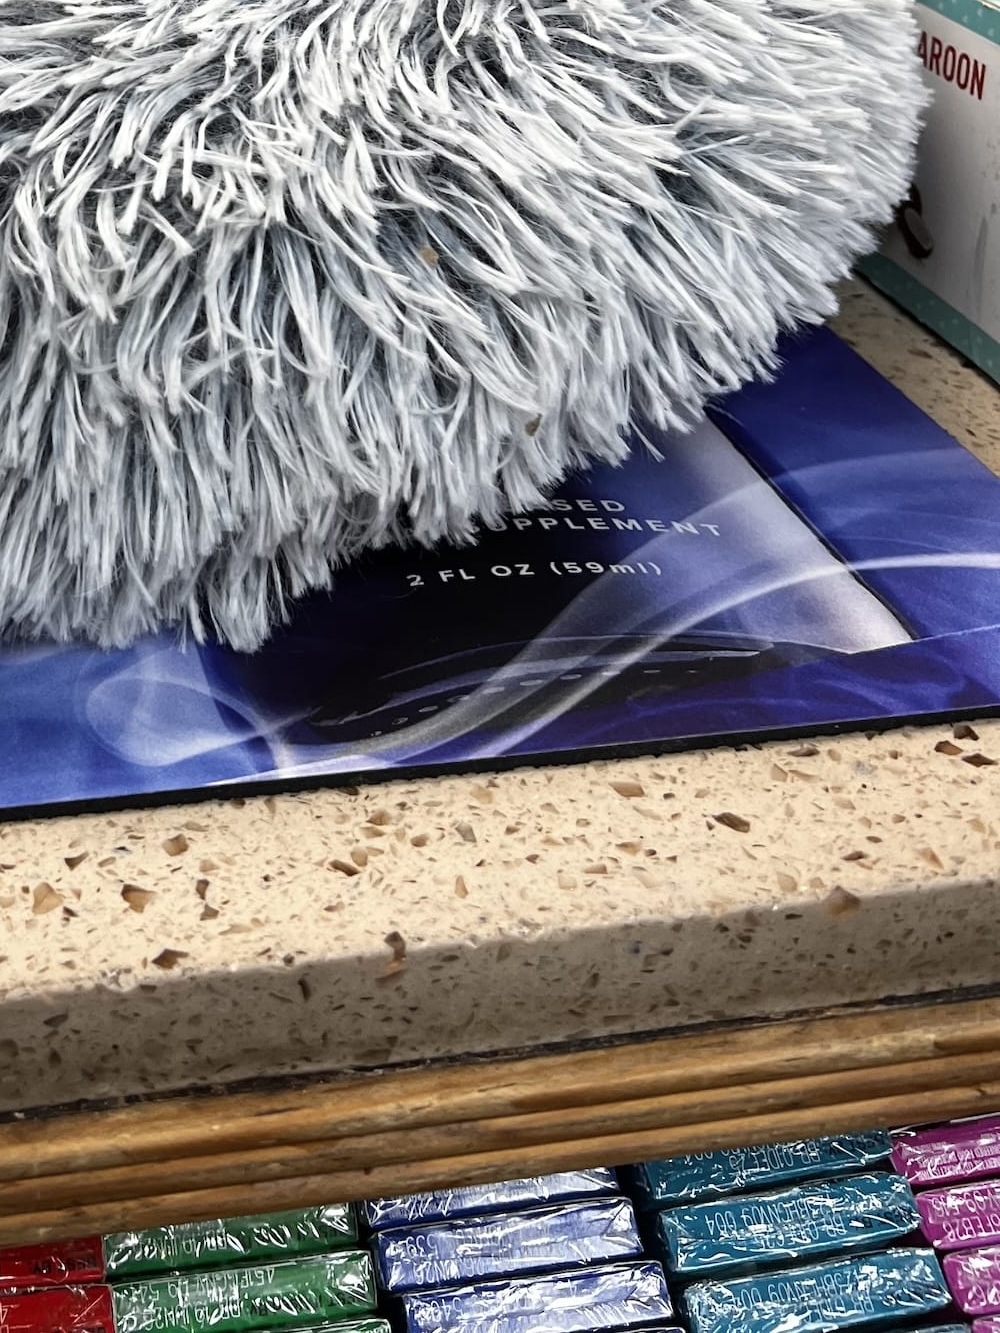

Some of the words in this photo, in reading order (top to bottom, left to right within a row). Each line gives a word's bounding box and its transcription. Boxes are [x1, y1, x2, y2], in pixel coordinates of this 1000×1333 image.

[471, 515, 721, 536] UPPLEMENT
[406, 574, 425, 587] 2
[438, 568, 476, 582] FL
[490, 563, 535, 577] OZ
[550, 561, 662, 576] (59ml)
